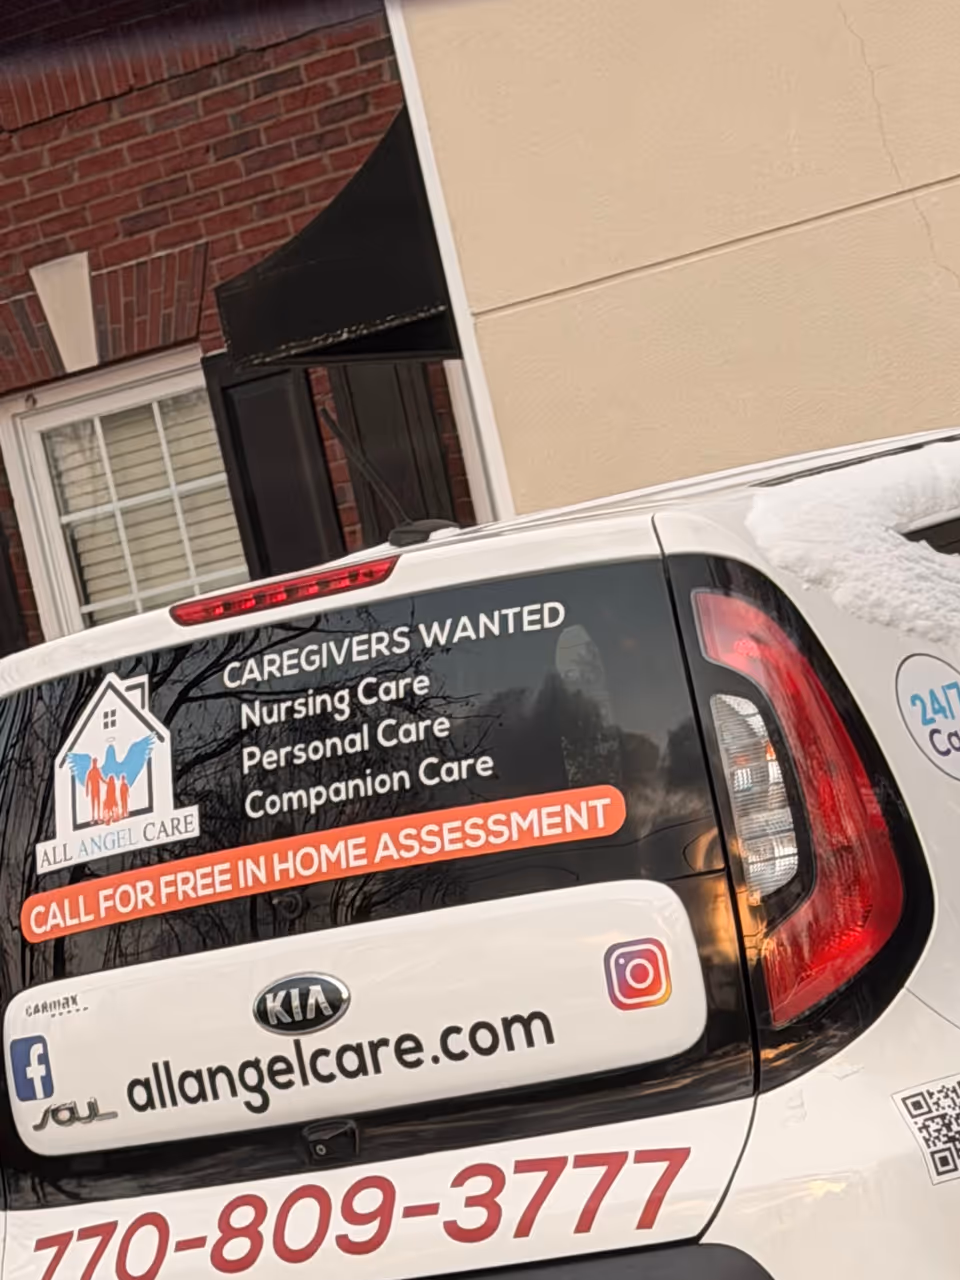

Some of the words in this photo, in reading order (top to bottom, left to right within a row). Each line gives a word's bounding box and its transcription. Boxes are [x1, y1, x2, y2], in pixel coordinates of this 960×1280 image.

[222, 626, 411, 688] CAREGIVERS
[419, 601, 566, 648] WANTED
[241, 689, 350, 730] Nursing
[357, 674, 430, 705] Care
[242, 723, 369, 775] Personal
[377, 715, 450, 747] Care
[245, 768, 411, 819] Companion
[418, 755, 494, 786] Care
[29, 893, 95, 935] CALL
[100, 878, 154, 918] FOR
[159, 861, 233, 906] FREE
[238, 857, 269, 889] IN
[273, 835, 367, 884] HOME
[373, 797, 612, 863] ASSESSMENT
[40, 843, 73, 868] ALL
[78, 828, 138, 858] ANGEL
[143, 814, 195, 842] CARE
[264, 985, 333, 1026] KIA
[126, 1009, 556, 1113] allangelcare.com
